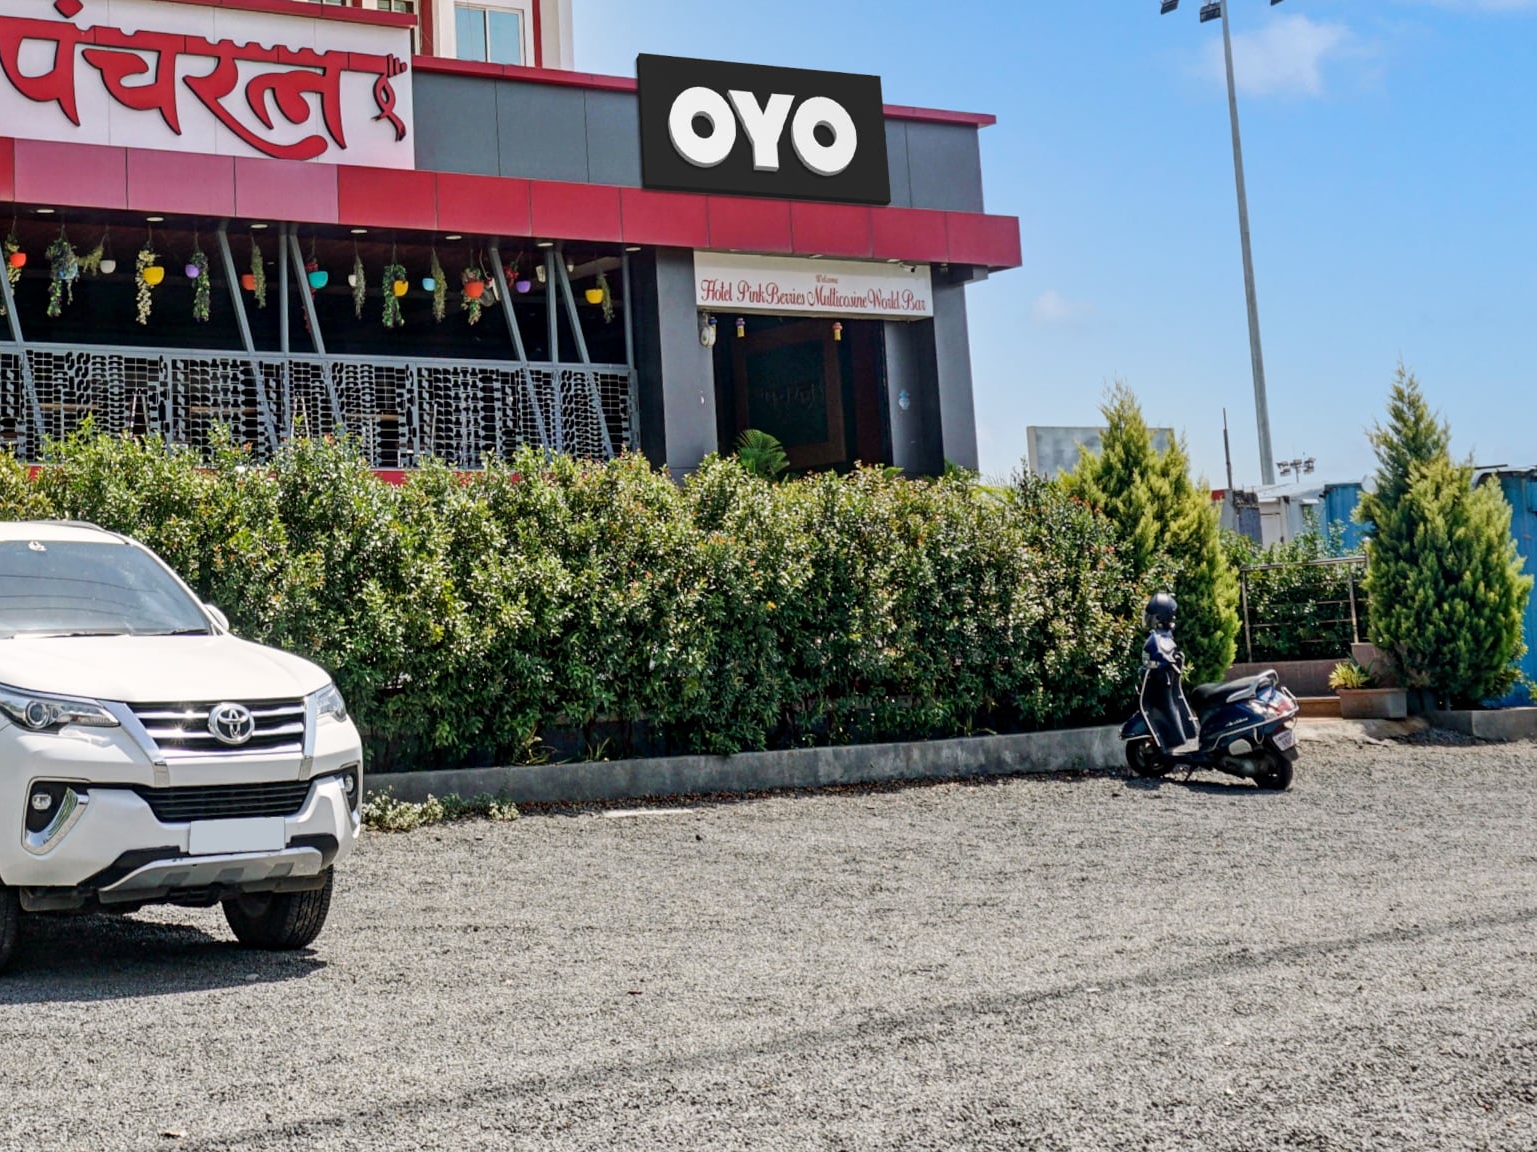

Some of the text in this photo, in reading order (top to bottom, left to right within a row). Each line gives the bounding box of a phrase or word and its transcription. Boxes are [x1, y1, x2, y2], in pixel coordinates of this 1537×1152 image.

[668, 86, 858, 177] OYO
[701, 279, 733, 302] Hotel
[736, 280, 765, 304] Pink
[765, 282, 805, 305] Berries
[867, 288, 901, 310] World
[902, 289, 926, 311] Bar
